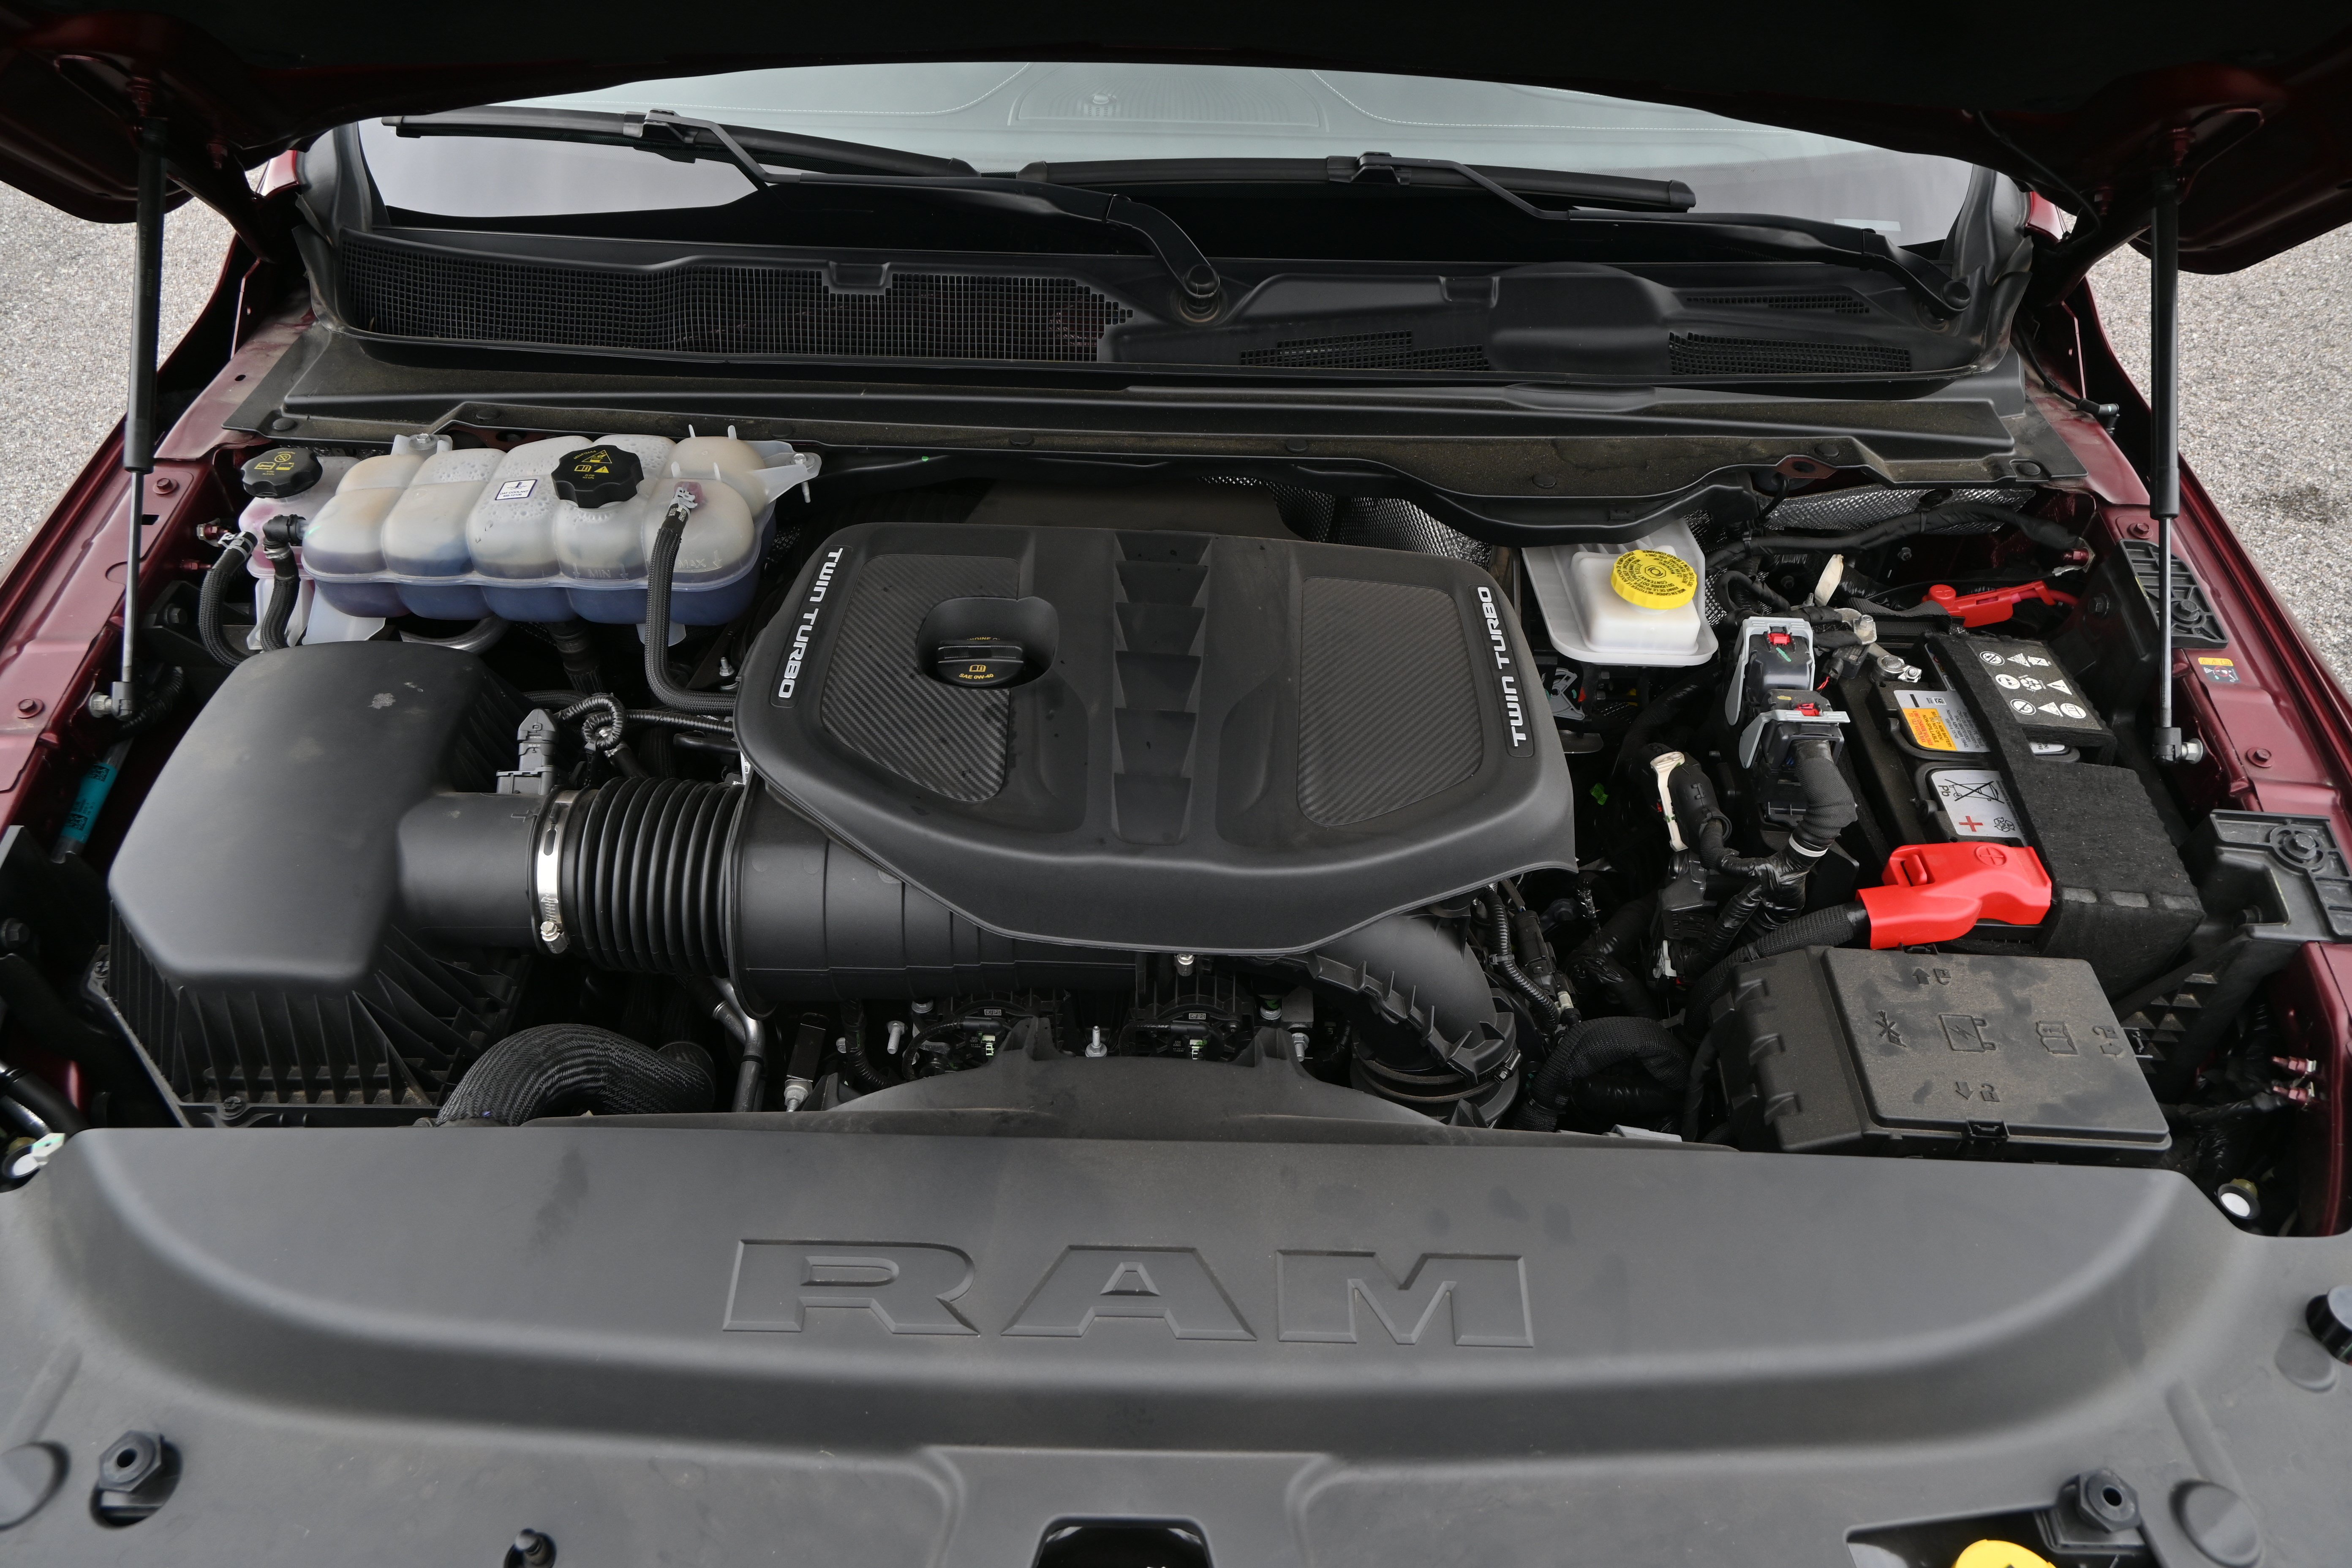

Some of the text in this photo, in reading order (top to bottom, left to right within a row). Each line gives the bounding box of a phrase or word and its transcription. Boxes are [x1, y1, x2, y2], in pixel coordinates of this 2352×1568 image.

[678, 558, 706, 568] MAX
[1667, 554, 1682, 562] SEALED
[589, 569, 611, 578] MIN
[1639, 575, 1667, 584] CONTENANT
[1631, 585, 1653, 594] NETTOYER
[778, 548, 843, 698] TWIN TURBO
[1478, 587, 1526, 747] TWIN TURBO
[1946, 710, 1954, 721] Normas
[1917, 719, 1927, 731] CHARGE
[1923, 732, 1933, 746] VOLTAGE
[1922, 714, 1939, 743] NON-SPILLABLE
[1942, 732, 1952, 747] BATTERY
[1938, 785, 1951, 797] Pb
[723, 1239, 1535, 1347] RAM
